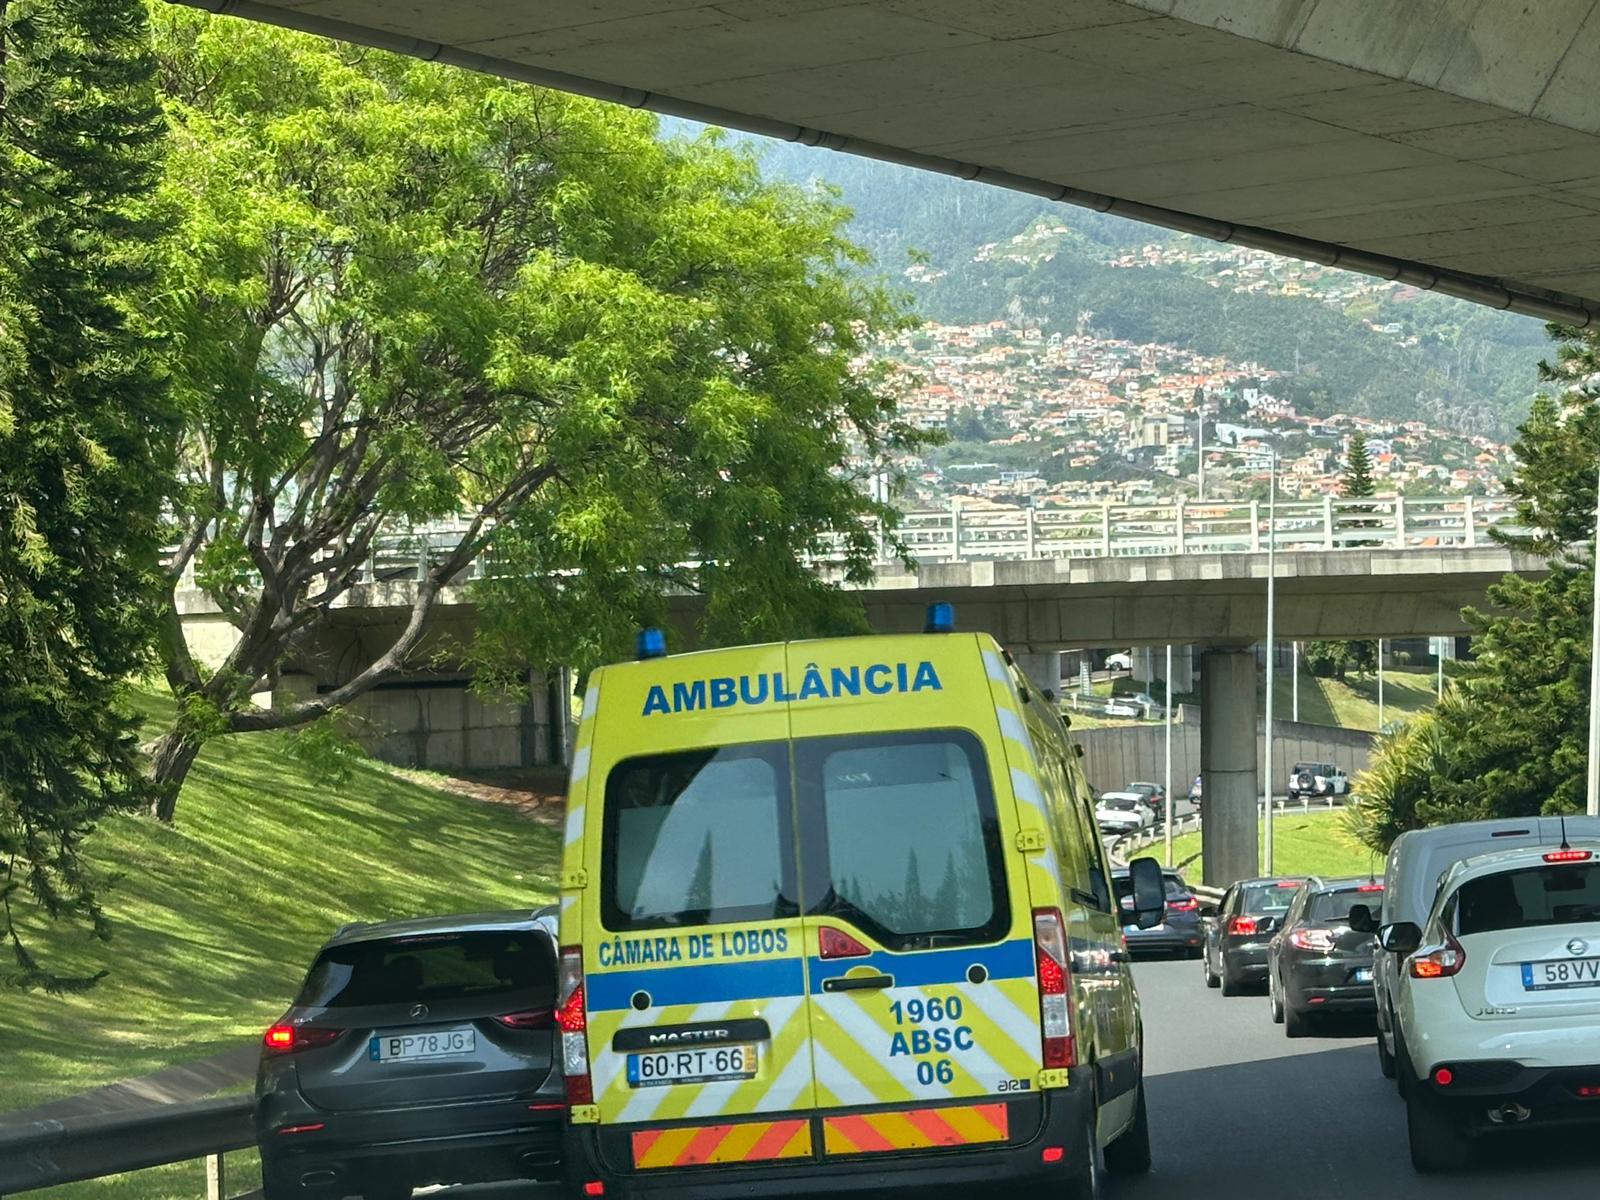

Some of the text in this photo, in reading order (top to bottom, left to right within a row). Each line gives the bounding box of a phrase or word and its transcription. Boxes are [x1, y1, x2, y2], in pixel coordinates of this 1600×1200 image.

[641, 661, 943, 716] AMBULÂNCIA
[599, 928, 788, 967] CÂMARA DE LOBOS
[889, 996, 963, 1025] 1960
[649, 1029, 729, 1043] MASTER
[889, 1025, 975, 1057] ABSC
[917, 1059, 954, 1086] 06
